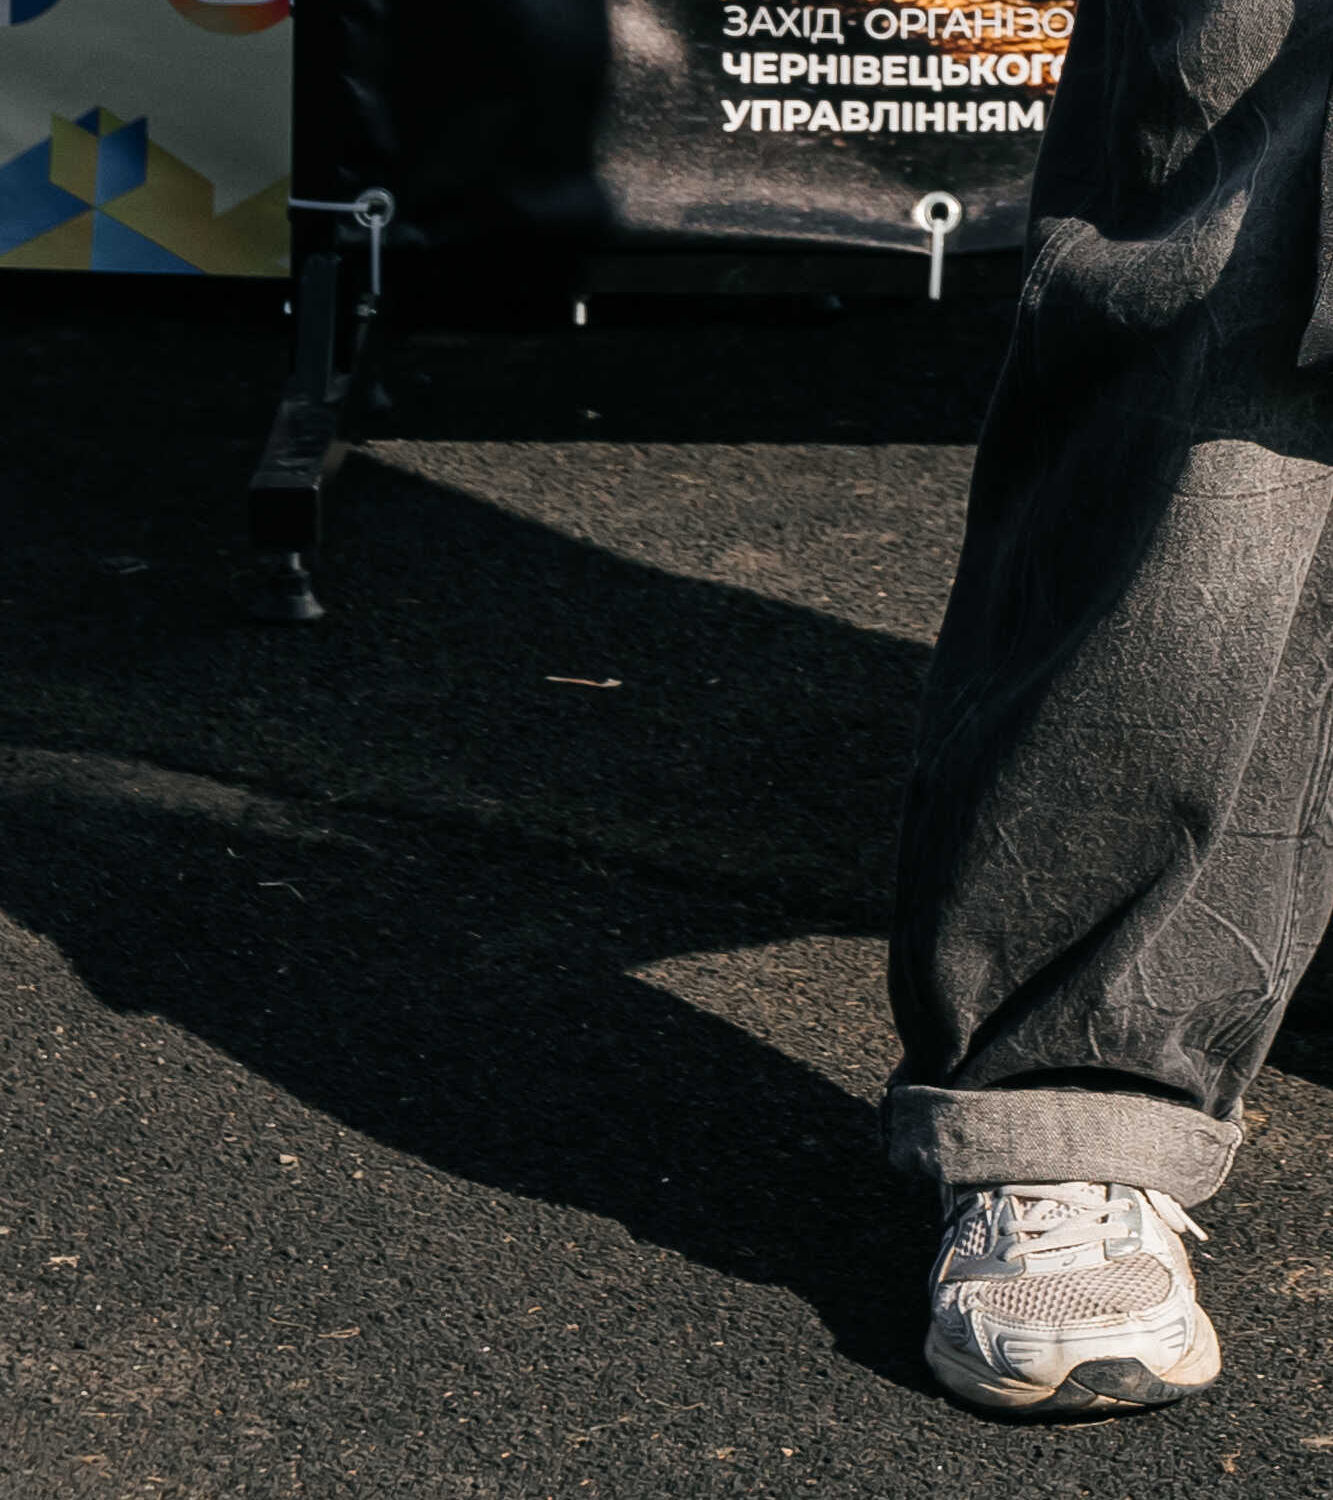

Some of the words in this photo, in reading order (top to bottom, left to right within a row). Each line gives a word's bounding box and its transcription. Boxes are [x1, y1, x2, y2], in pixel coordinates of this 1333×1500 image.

[722, 5, 844, 44] ЗАХІД
[864, 7, 1074, 41] ОРГАНІЗО
[721, 100, 1044, 133] УПРАВЛІННЯМ
